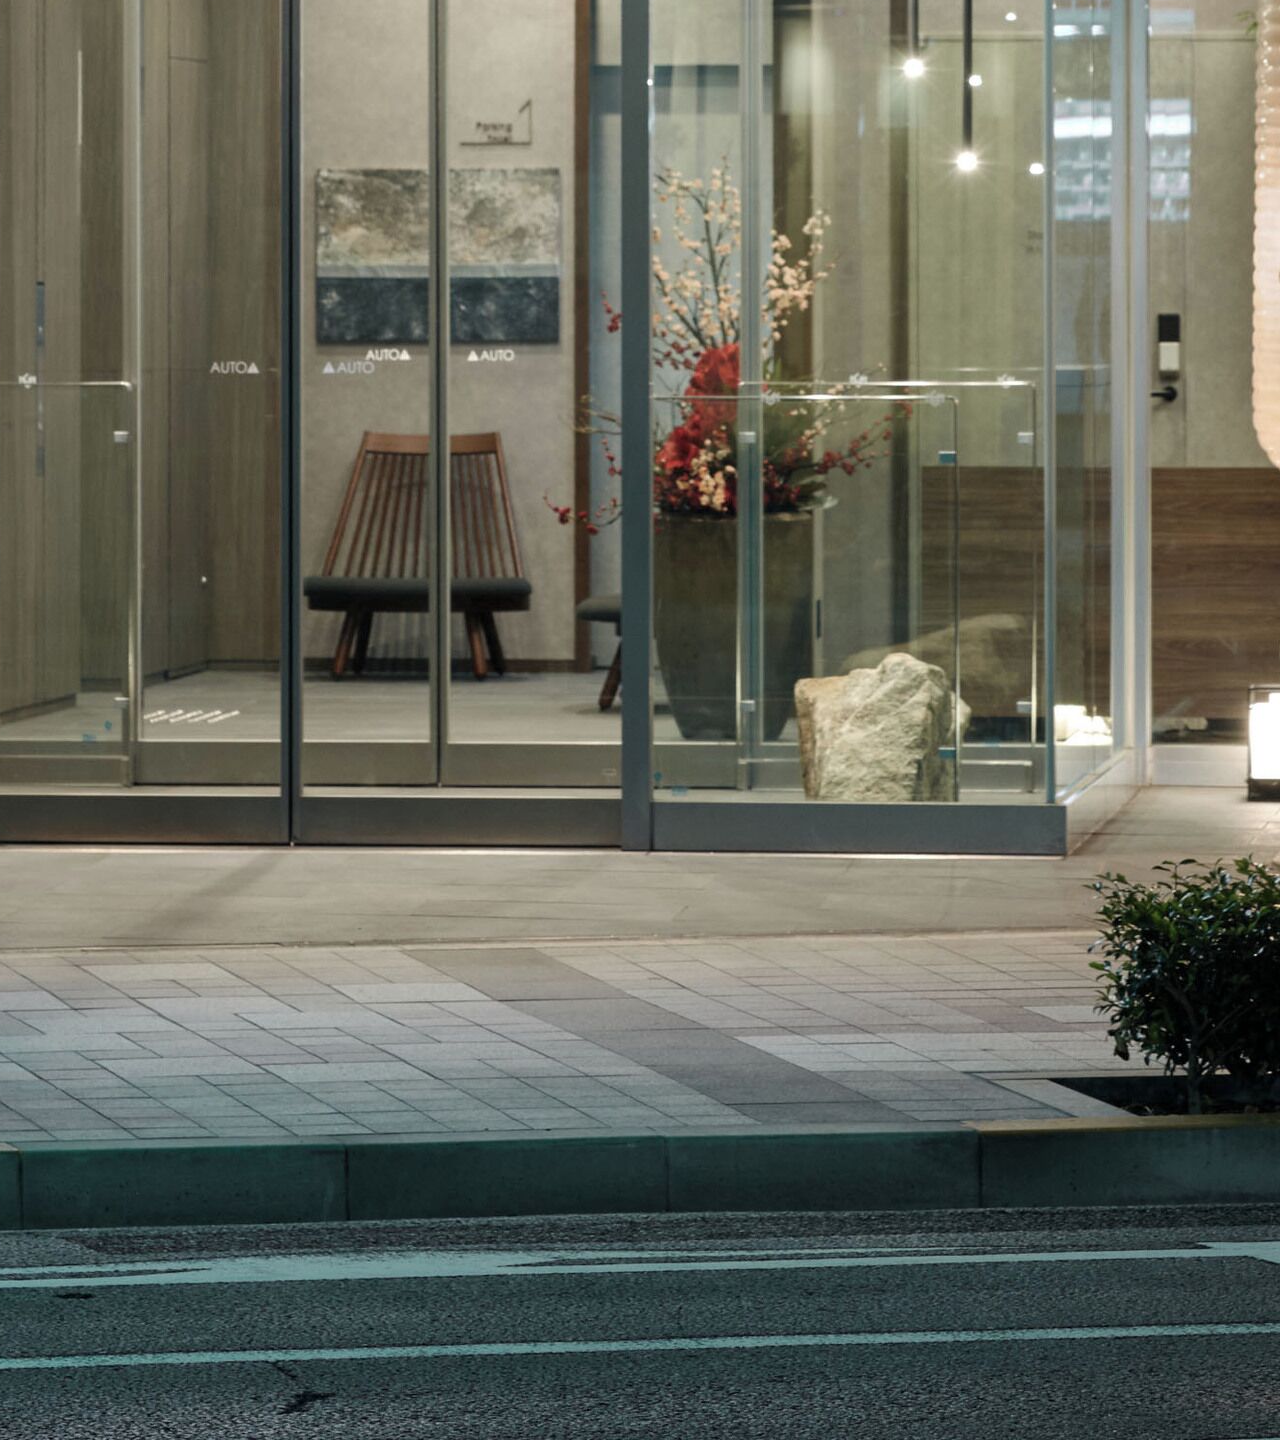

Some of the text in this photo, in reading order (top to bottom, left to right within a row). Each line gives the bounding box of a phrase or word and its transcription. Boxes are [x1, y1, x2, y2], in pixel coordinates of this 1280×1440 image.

[365, 349, 401, 361] AUTO
[479, 349, 515, 361] AUTO
[210, 361, 248, 375] AUTO
[337, 361, 375, 375] AUTO
